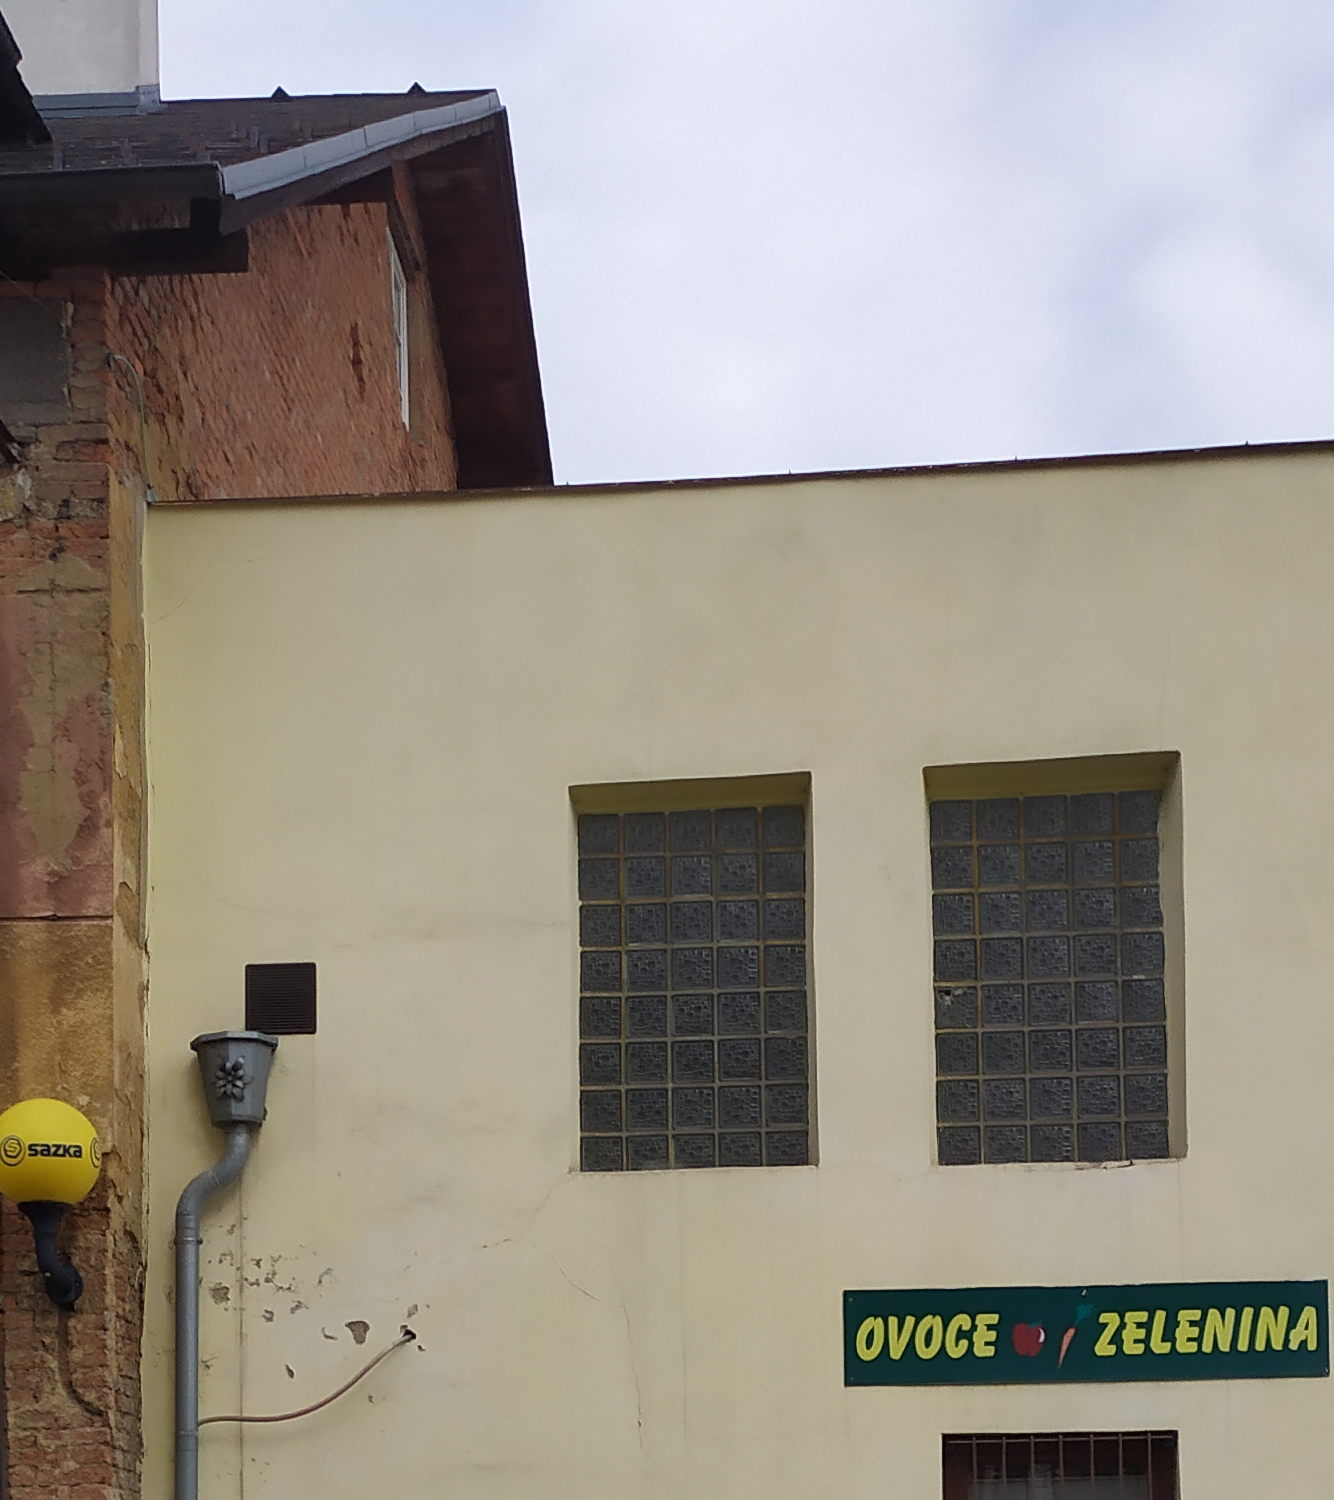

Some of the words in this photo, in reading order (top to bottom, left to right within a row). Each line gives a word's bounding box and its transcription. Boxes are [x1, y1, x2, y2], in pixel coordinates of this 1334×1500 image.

[28, 1143, 83, 1161] sazka
[856, 1313, 1000, 1362] OVOCE
[1094, 1305, 1317, 1357] ZELENINA
